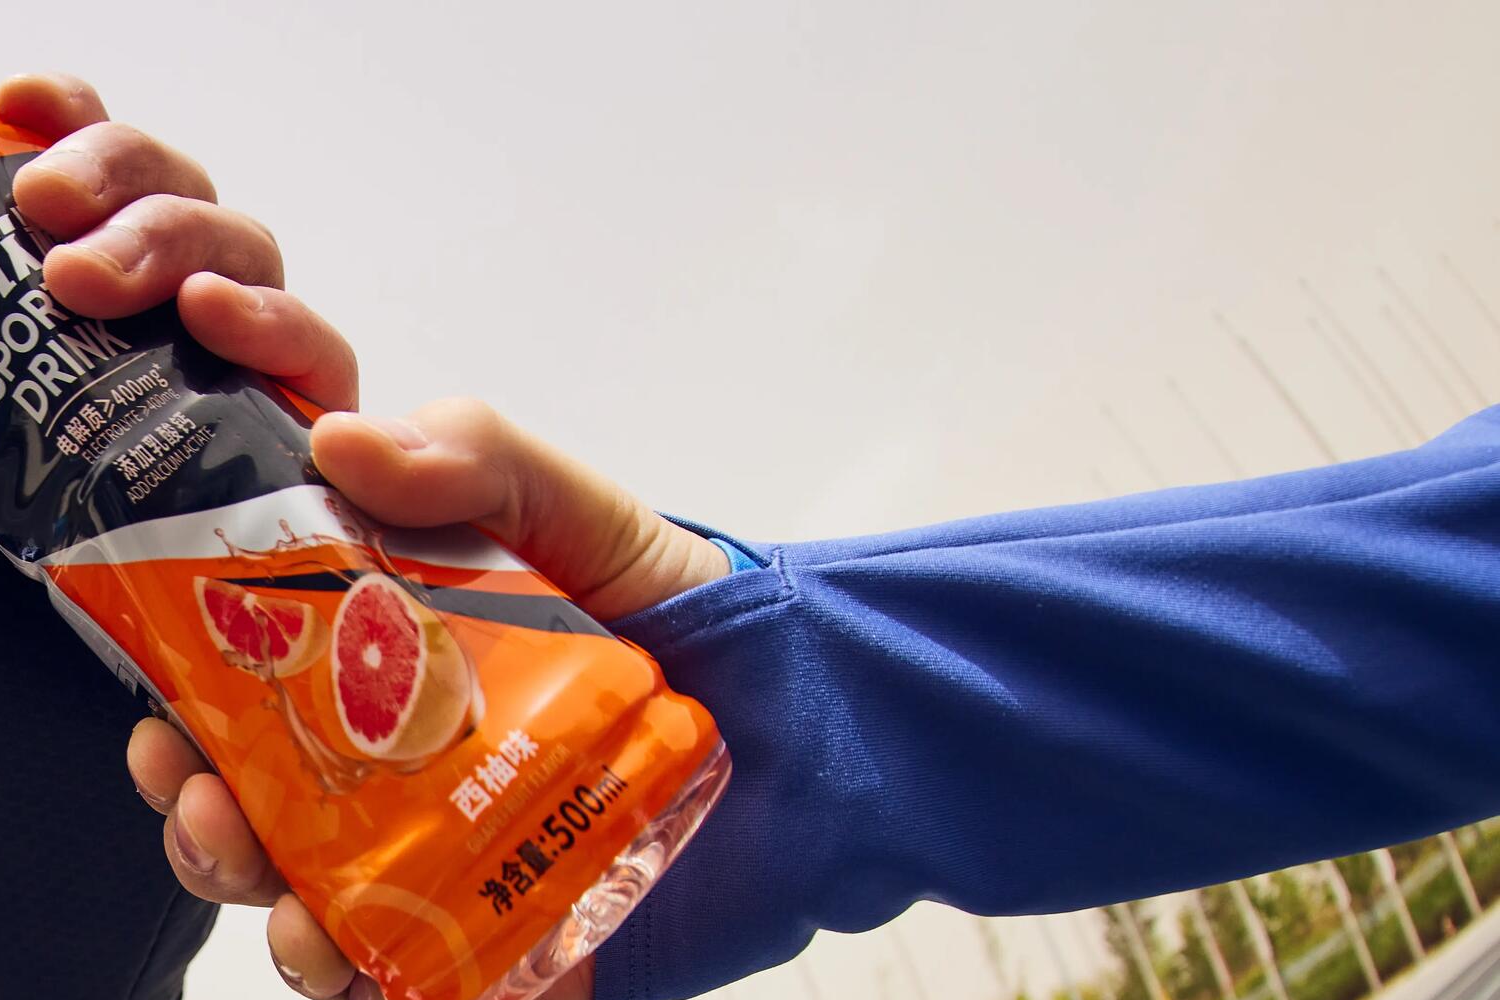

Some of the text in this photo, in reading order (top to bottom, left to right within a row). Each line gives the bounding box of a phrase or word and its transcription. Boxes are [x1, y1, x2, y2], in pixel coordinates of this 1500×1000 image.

[12, 320, 132, 424] DRINK
[82, 409, 144, 465] ELECTROLYTE
[113, 411, 196, 481] 添加乳酸钙
[126, 425, 216, 504] ADD CALCIUM LACTATE
[450, 729, 539, 822] 西柚味
